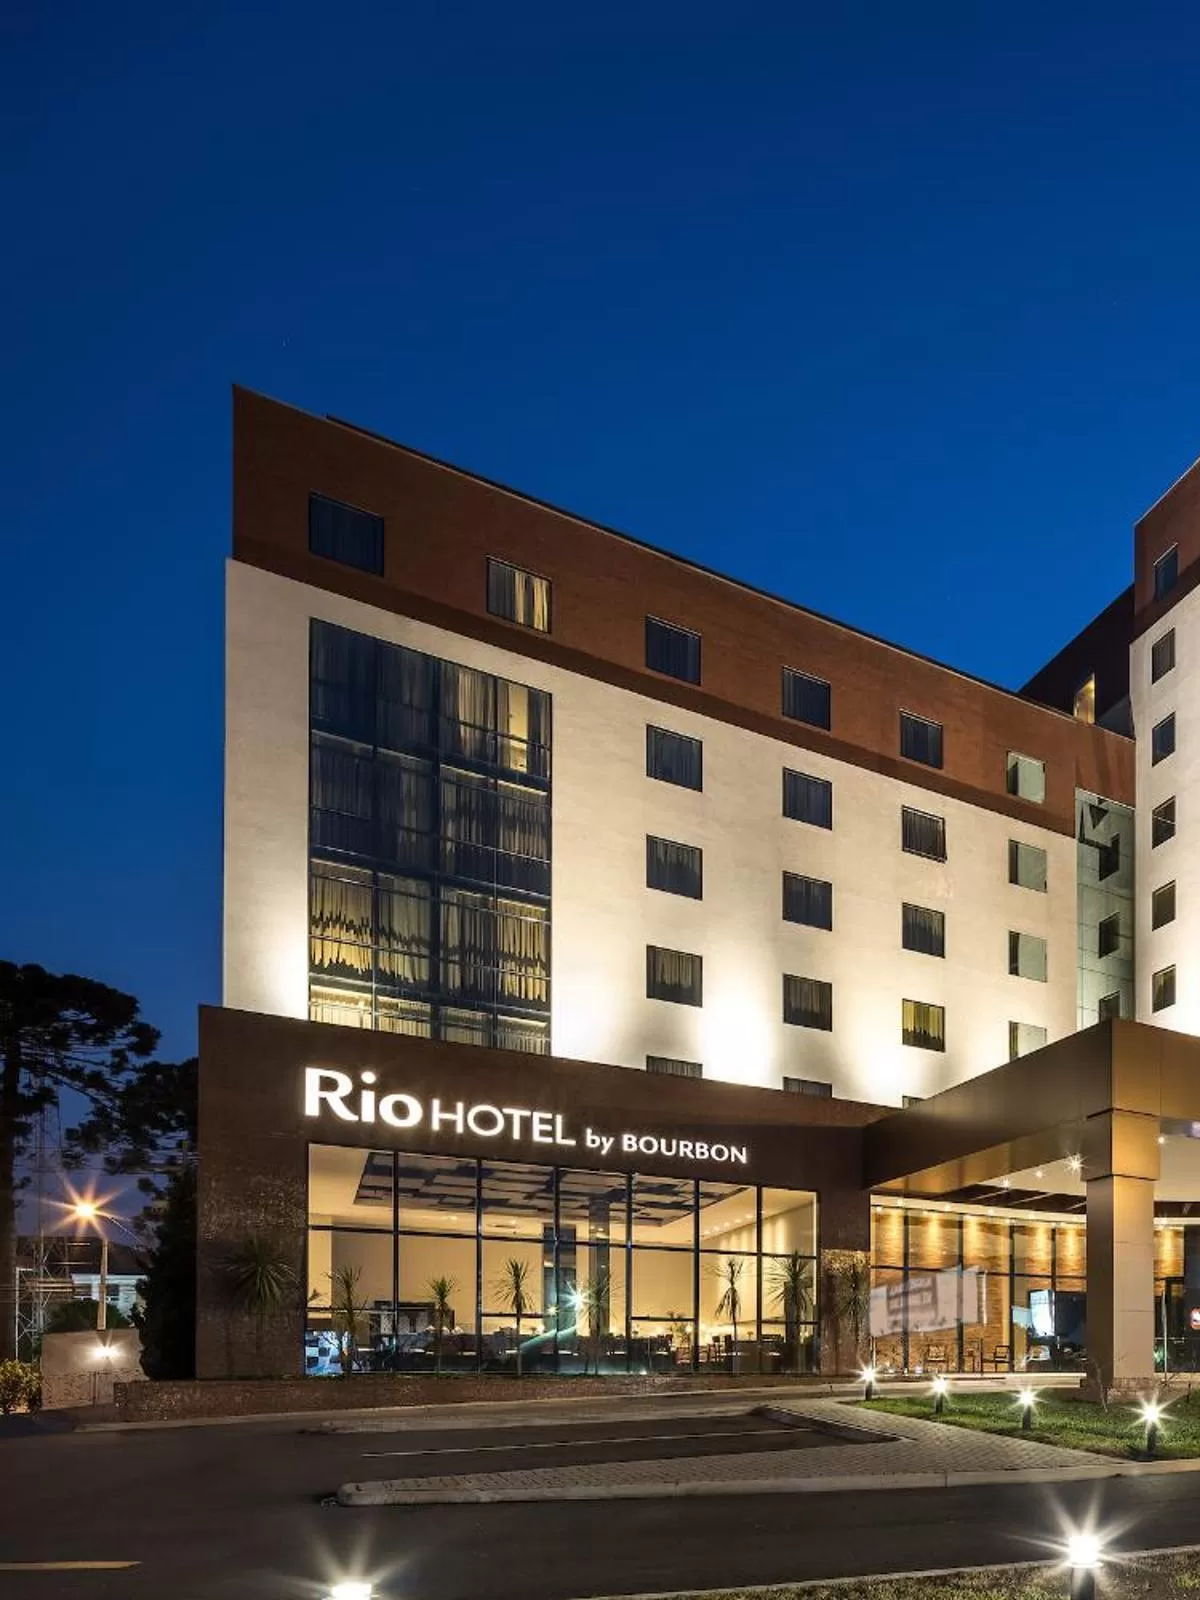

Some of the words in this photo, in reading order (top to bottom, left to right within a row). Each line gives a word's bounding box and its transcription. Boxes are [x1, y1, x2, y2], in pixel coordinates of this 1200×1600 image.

[304, 1067, 424, 1128] Rio
[431, 1098, 576, 1146] HOTEL
[586, 1127, 615, 1156] by
[622, 1133, 748, 1164] BOURBON
